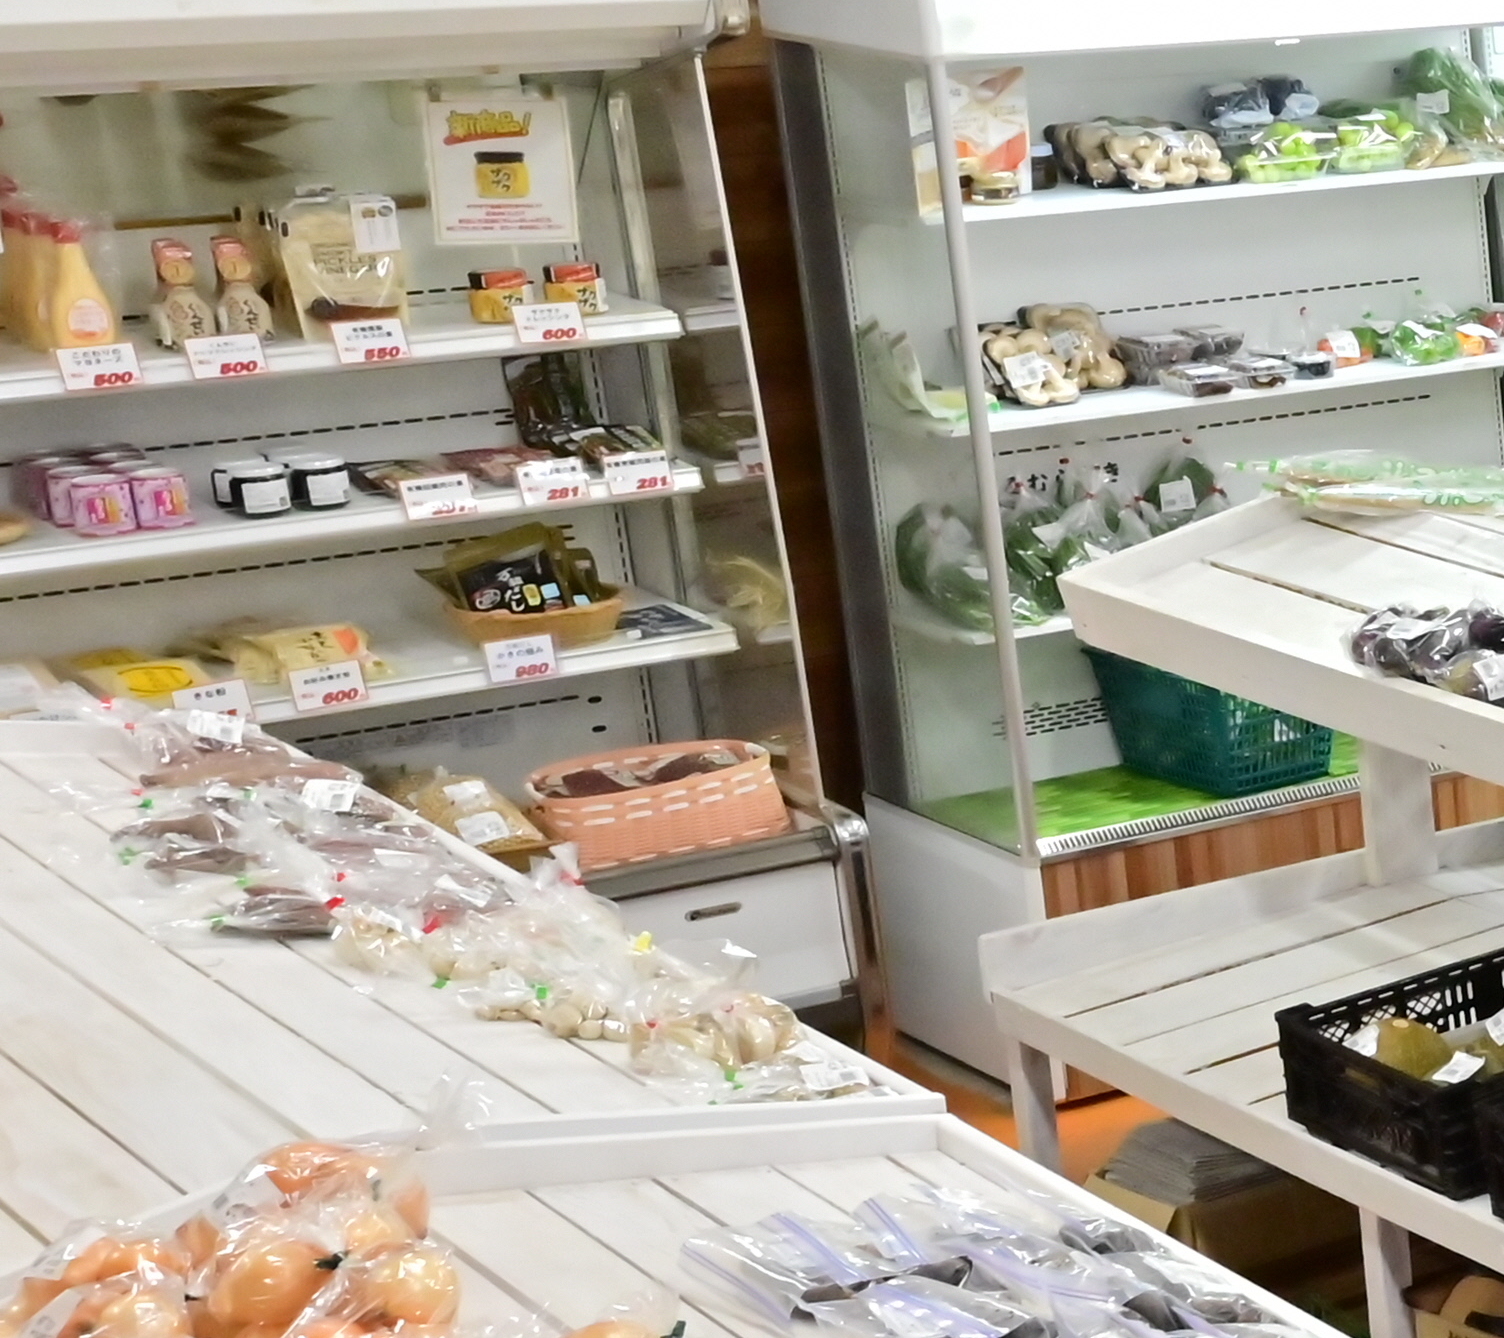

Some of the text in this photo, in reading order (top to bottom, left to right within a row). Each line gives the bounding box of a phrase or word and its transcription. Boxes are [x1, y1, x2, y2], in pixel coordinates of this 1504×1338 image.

[542, 327, 577, 341] 600
[219, 360, 259, 376] 500
[93, 371, 134, 387] 500
[547, 485, 580, 501] 281
[321, 687, 360, 705] 600
